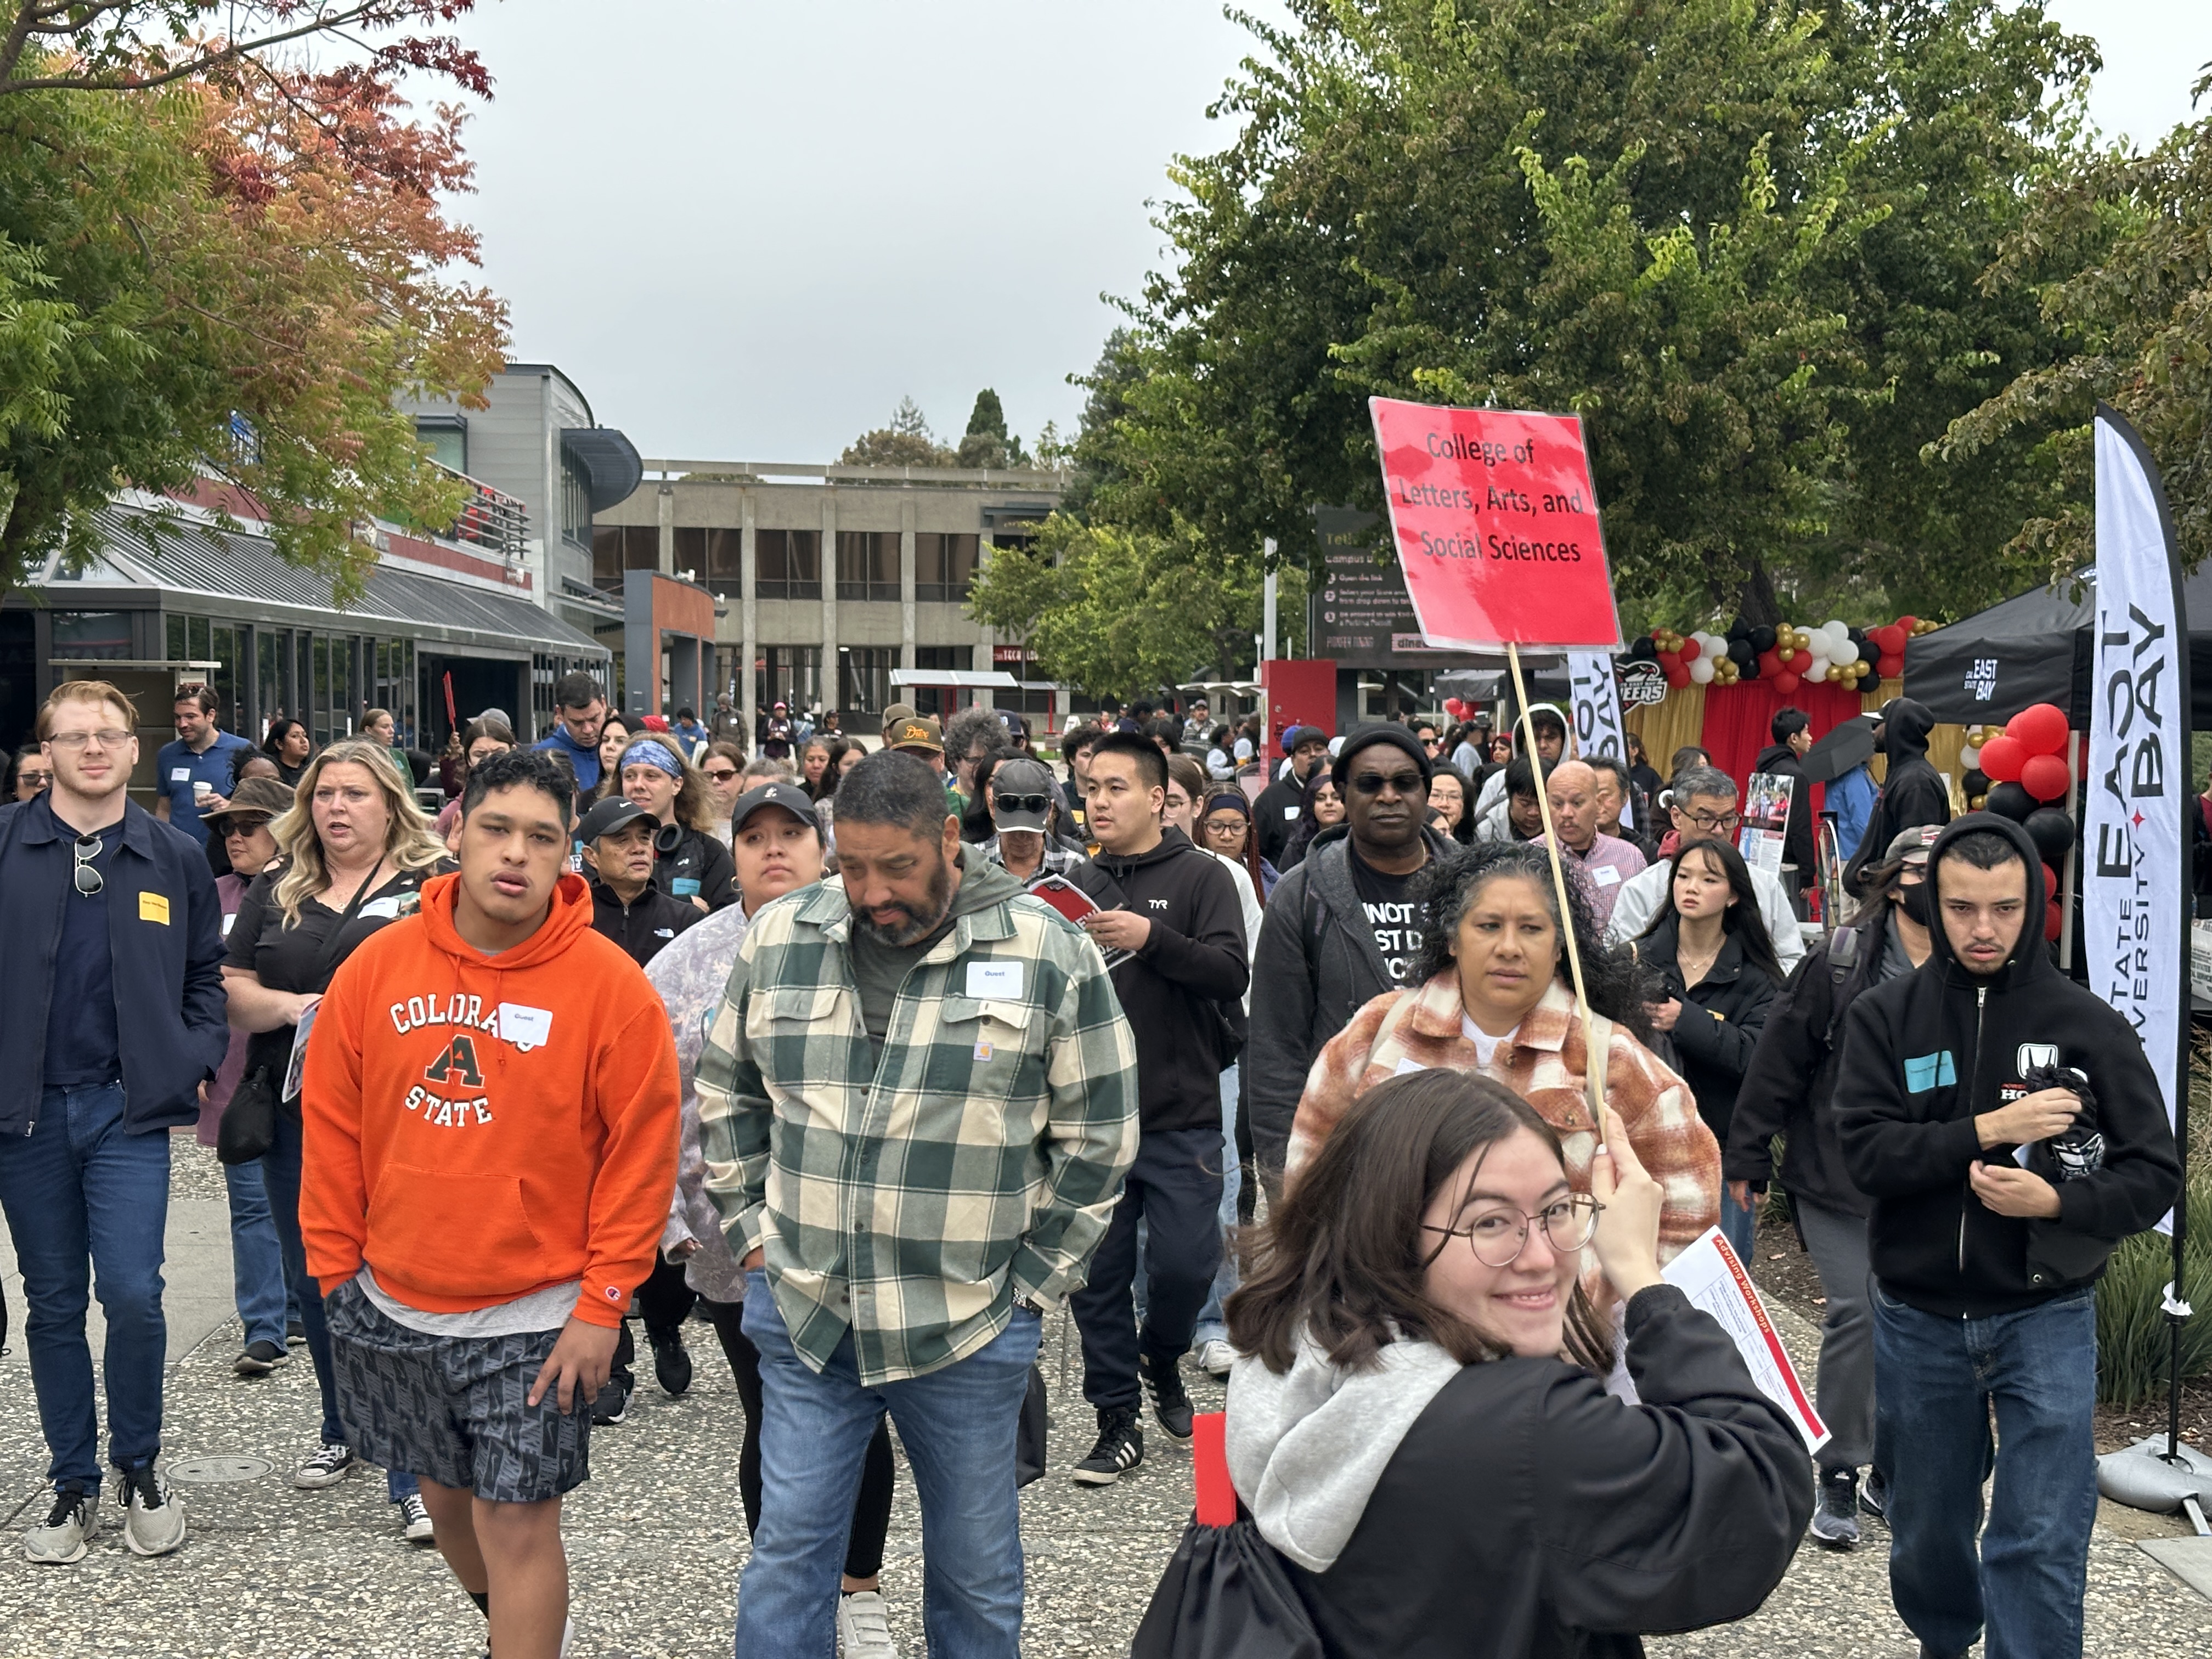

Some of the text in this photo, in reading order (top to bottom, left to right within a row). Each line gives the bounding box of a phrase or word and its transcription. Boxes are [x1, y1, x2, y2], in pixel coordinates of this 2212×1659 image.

[1426, 432, 1533, 467] College of
[1399, 478, 1583, 517] Letters, Arts, and
[1420, 531, 1581, 562] Social Sciences
[1973, 659, 1997, 679] EAST
[1621, 686, 1663, 702] EERS
[1976, 680, 1996, 701] BAY
[2129, 602, 2165, 798] BAY
[1148, 899, 1168, 910] TYR
[1374, 930, 1401, 951] ST
[2110, 898, 2132, 1015] TATE
[389, 993, 533, 1052] COLORA
[515, 1013, 534, 1022] Guest
[424, 1034, 486, 1089] A
[405, 1084, 493, 1127] STATE
[1716, 1238, 1742, 1280] Advising
[1740, 1279, 1770, 1333] Workshops
